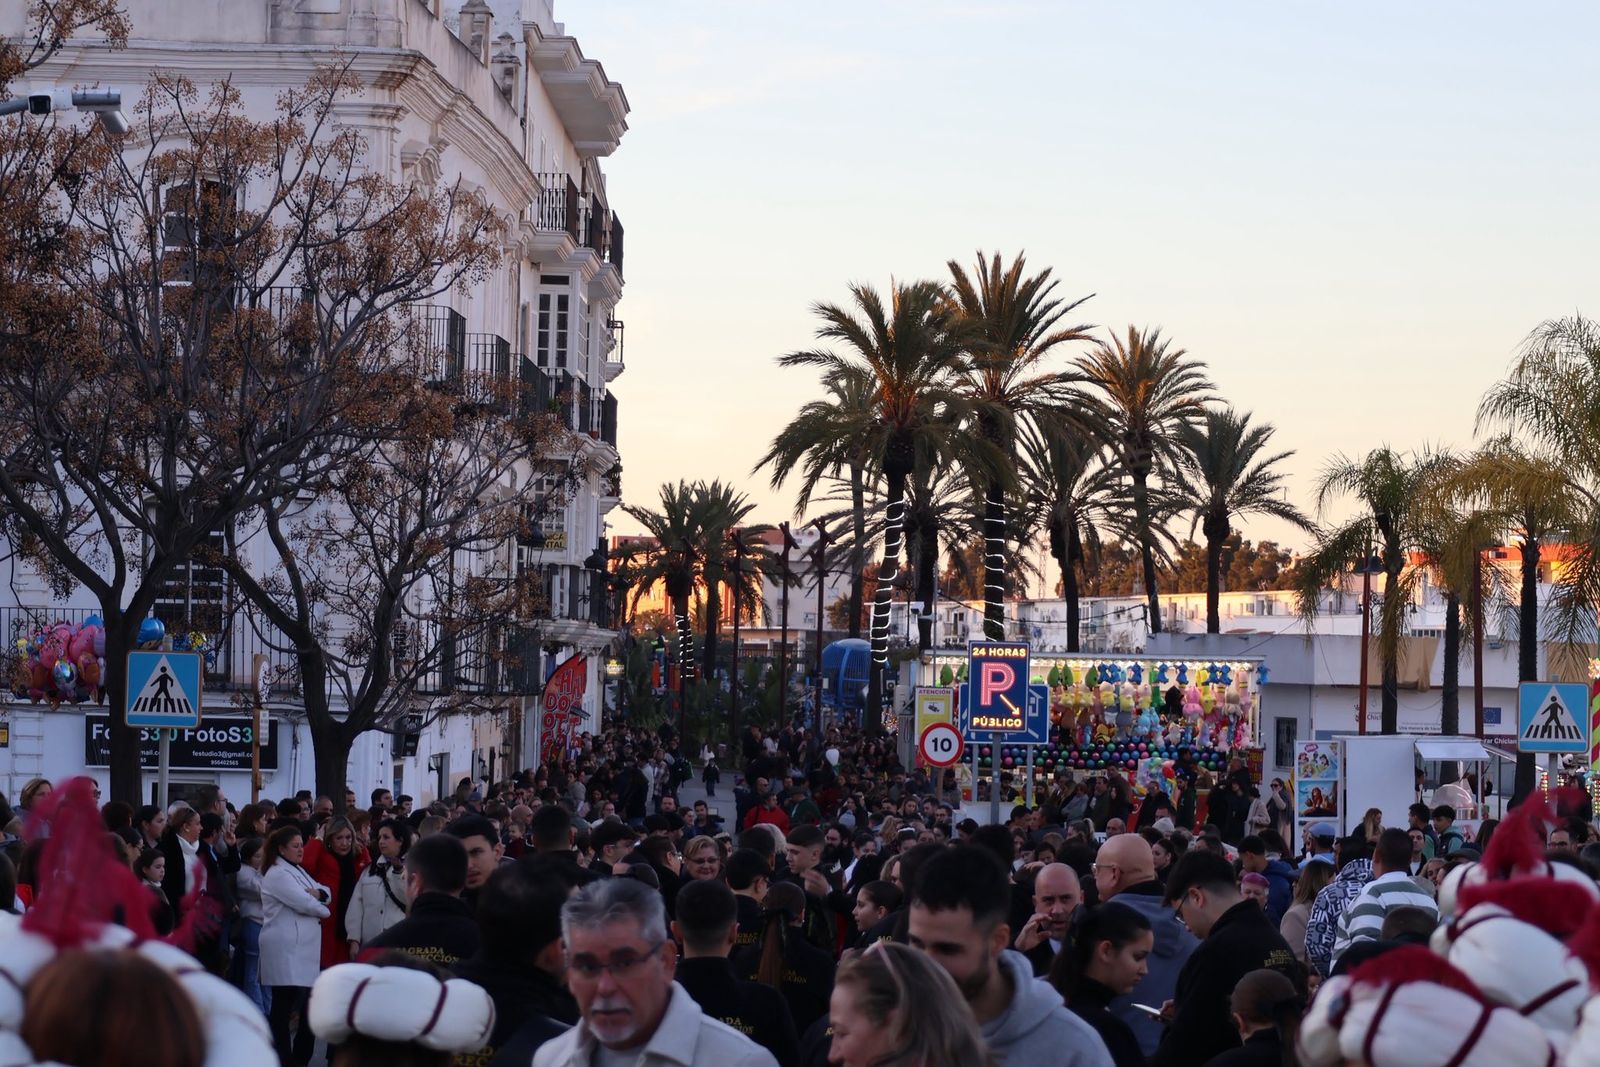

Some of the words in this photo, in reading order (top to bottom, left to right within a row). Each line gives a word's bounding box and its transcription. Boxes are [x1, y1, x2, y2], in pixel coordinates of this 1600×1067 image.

[972, 647, 986, 656] 24
[989, 647, 1026, 657] HORAS
[981, 662, 1015, 706] P
[184, 726, 253, 743] FotoS3
[931, 737, 952, 752] 10
[192, 749, 253, 759] festudio3@gmail.co
